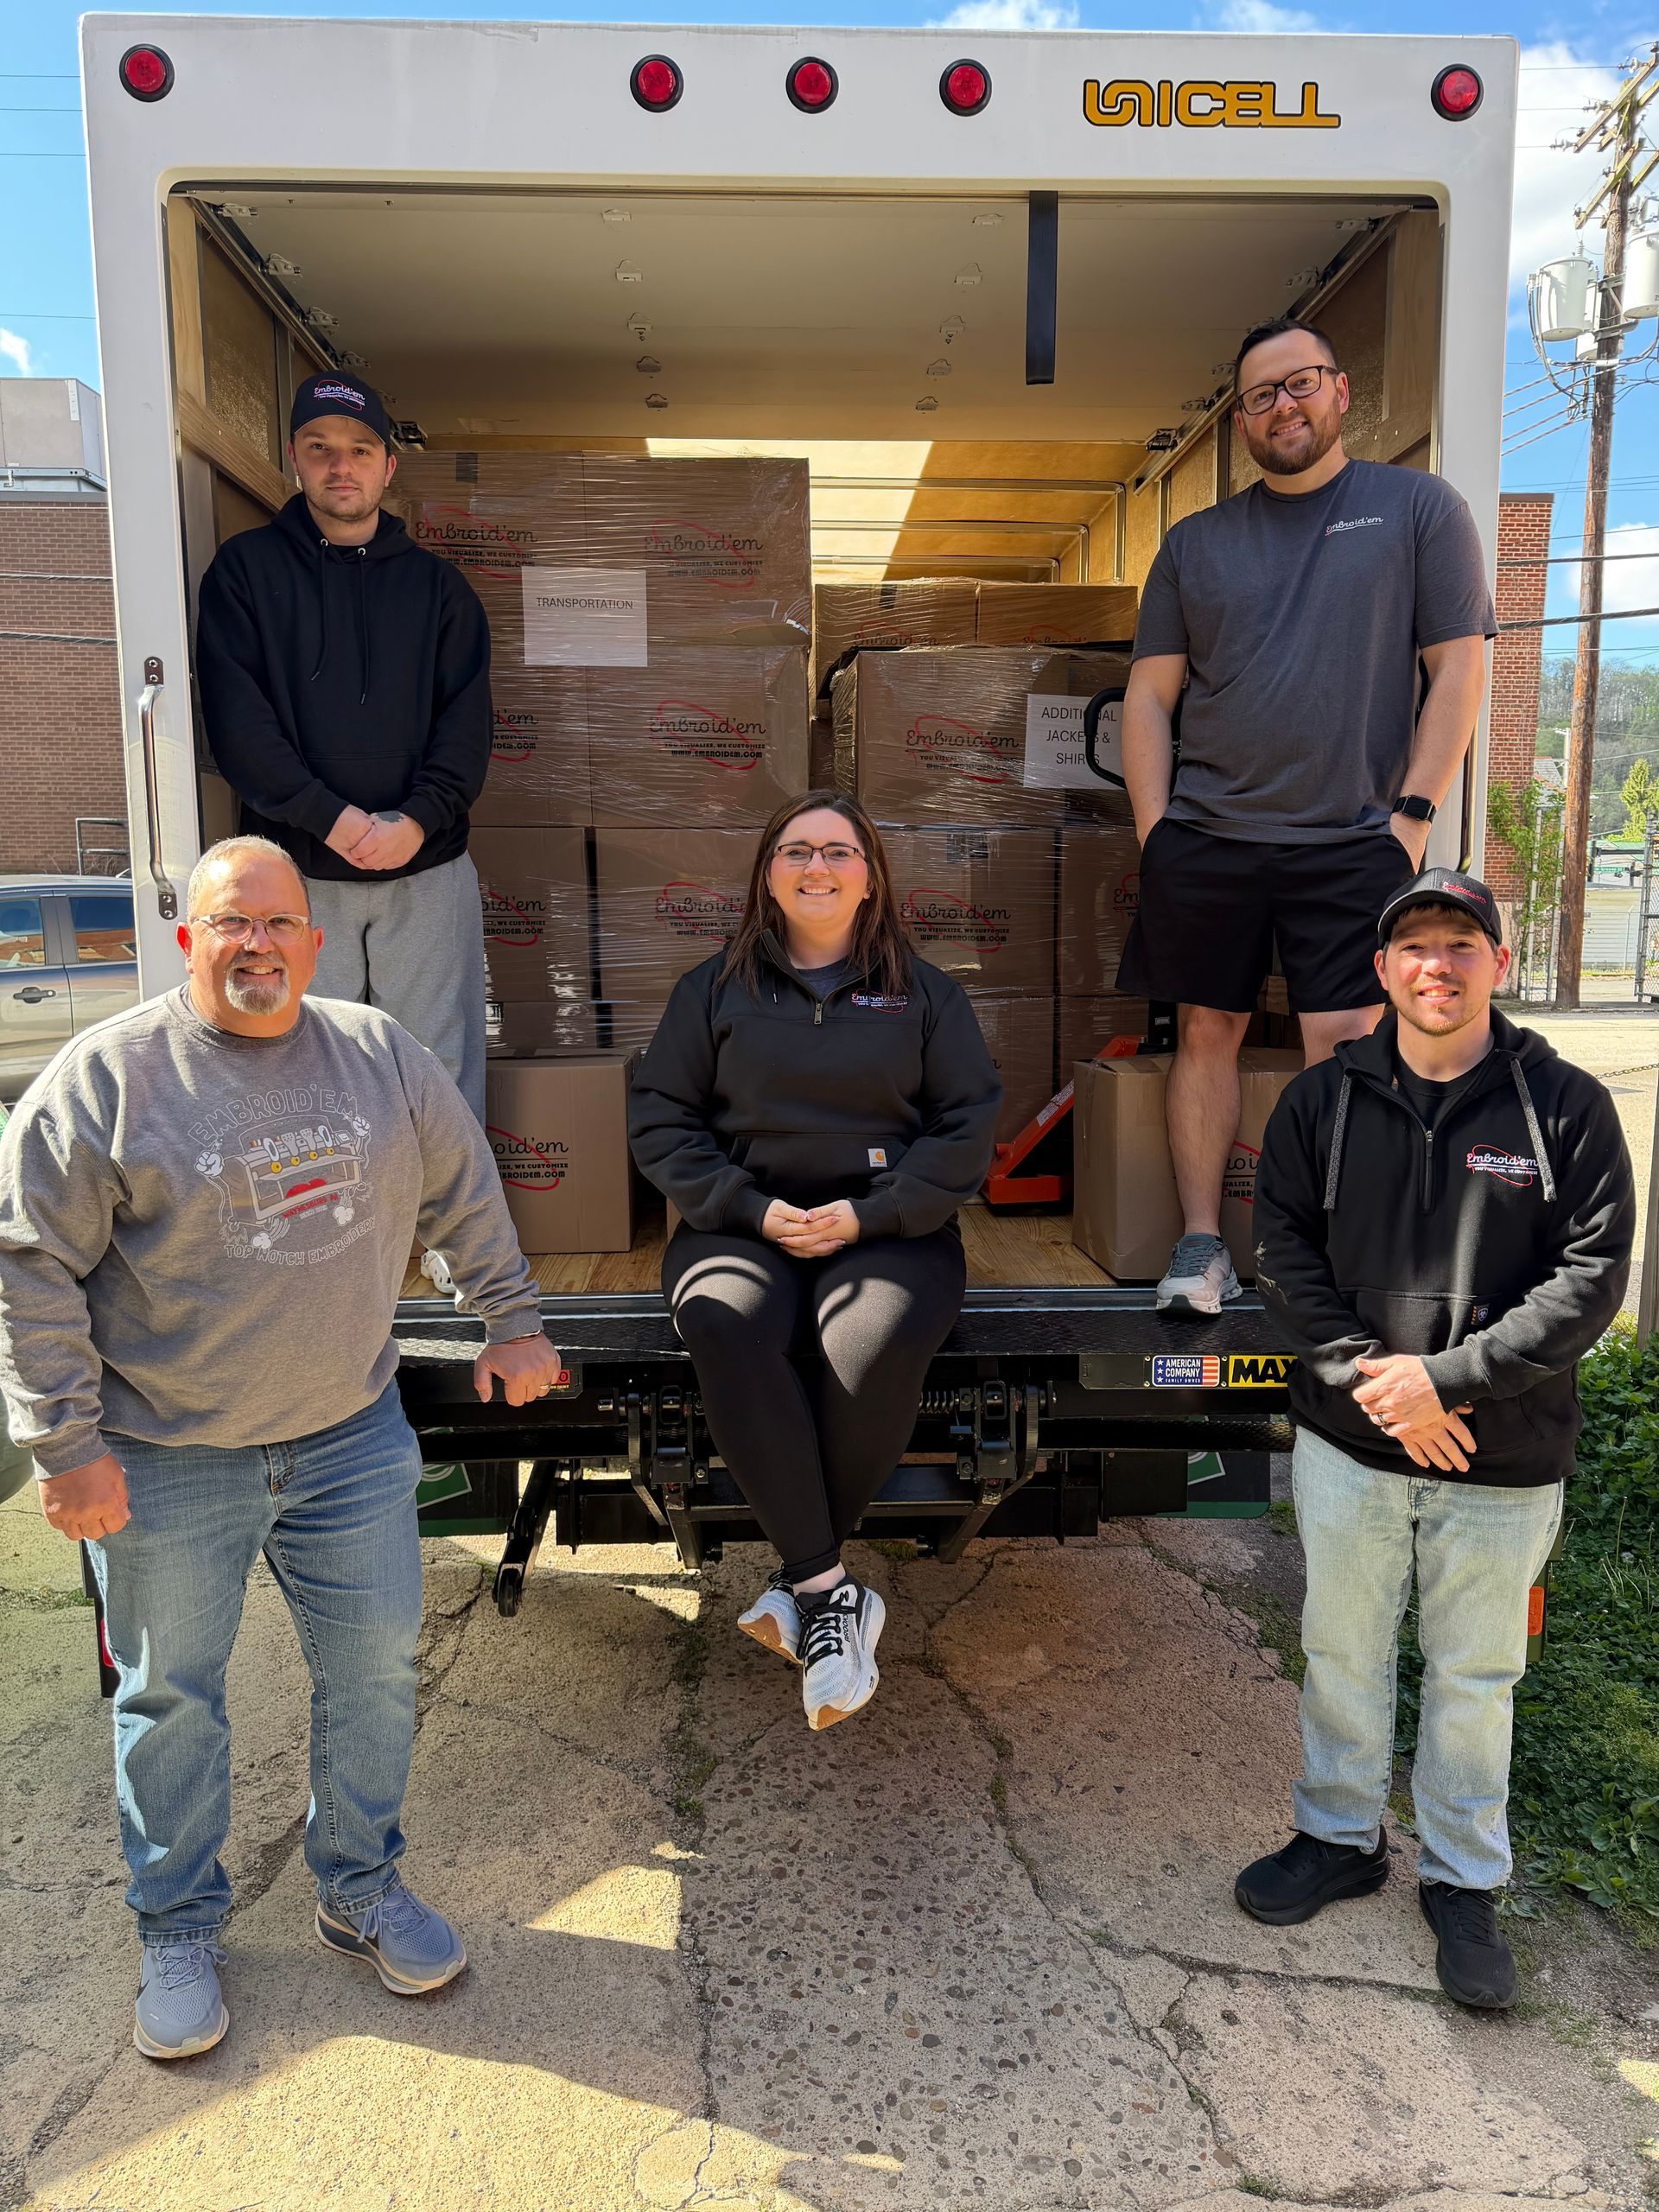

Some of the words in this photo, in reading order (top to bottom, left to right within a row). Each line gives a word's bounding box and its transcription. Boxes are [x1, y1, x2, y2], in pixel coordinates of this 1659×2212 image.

[1325, 517, 1384, 533] Embroid'em
[416, 522, 537, 543] Embroid'em
[536, 597, 633, 609] TRANSPORTATION
[649, 716, 766, 734] Embroid'em
[1046, 730, 1099, 743] JACKES
[1102, 732, 1111, 743] &
[1056, 753, 1100, 765] SHIRS
[900, 903, 1012, 919] Embroid'em
[188, 1084, 359, 1147] EMBROID'EM
[1466, 1153, 1538, 1166] Embroid'em
[224, 1243, 254, 1259] TOP
[257, 1246, 305, 1266] NOTCH
[308, 1215, 377, 1264] EMBROIDERY
[1165, 1358, 1201, 1368] AMERICAN
[1165, 1368, 1201, 1378] COMPANY
